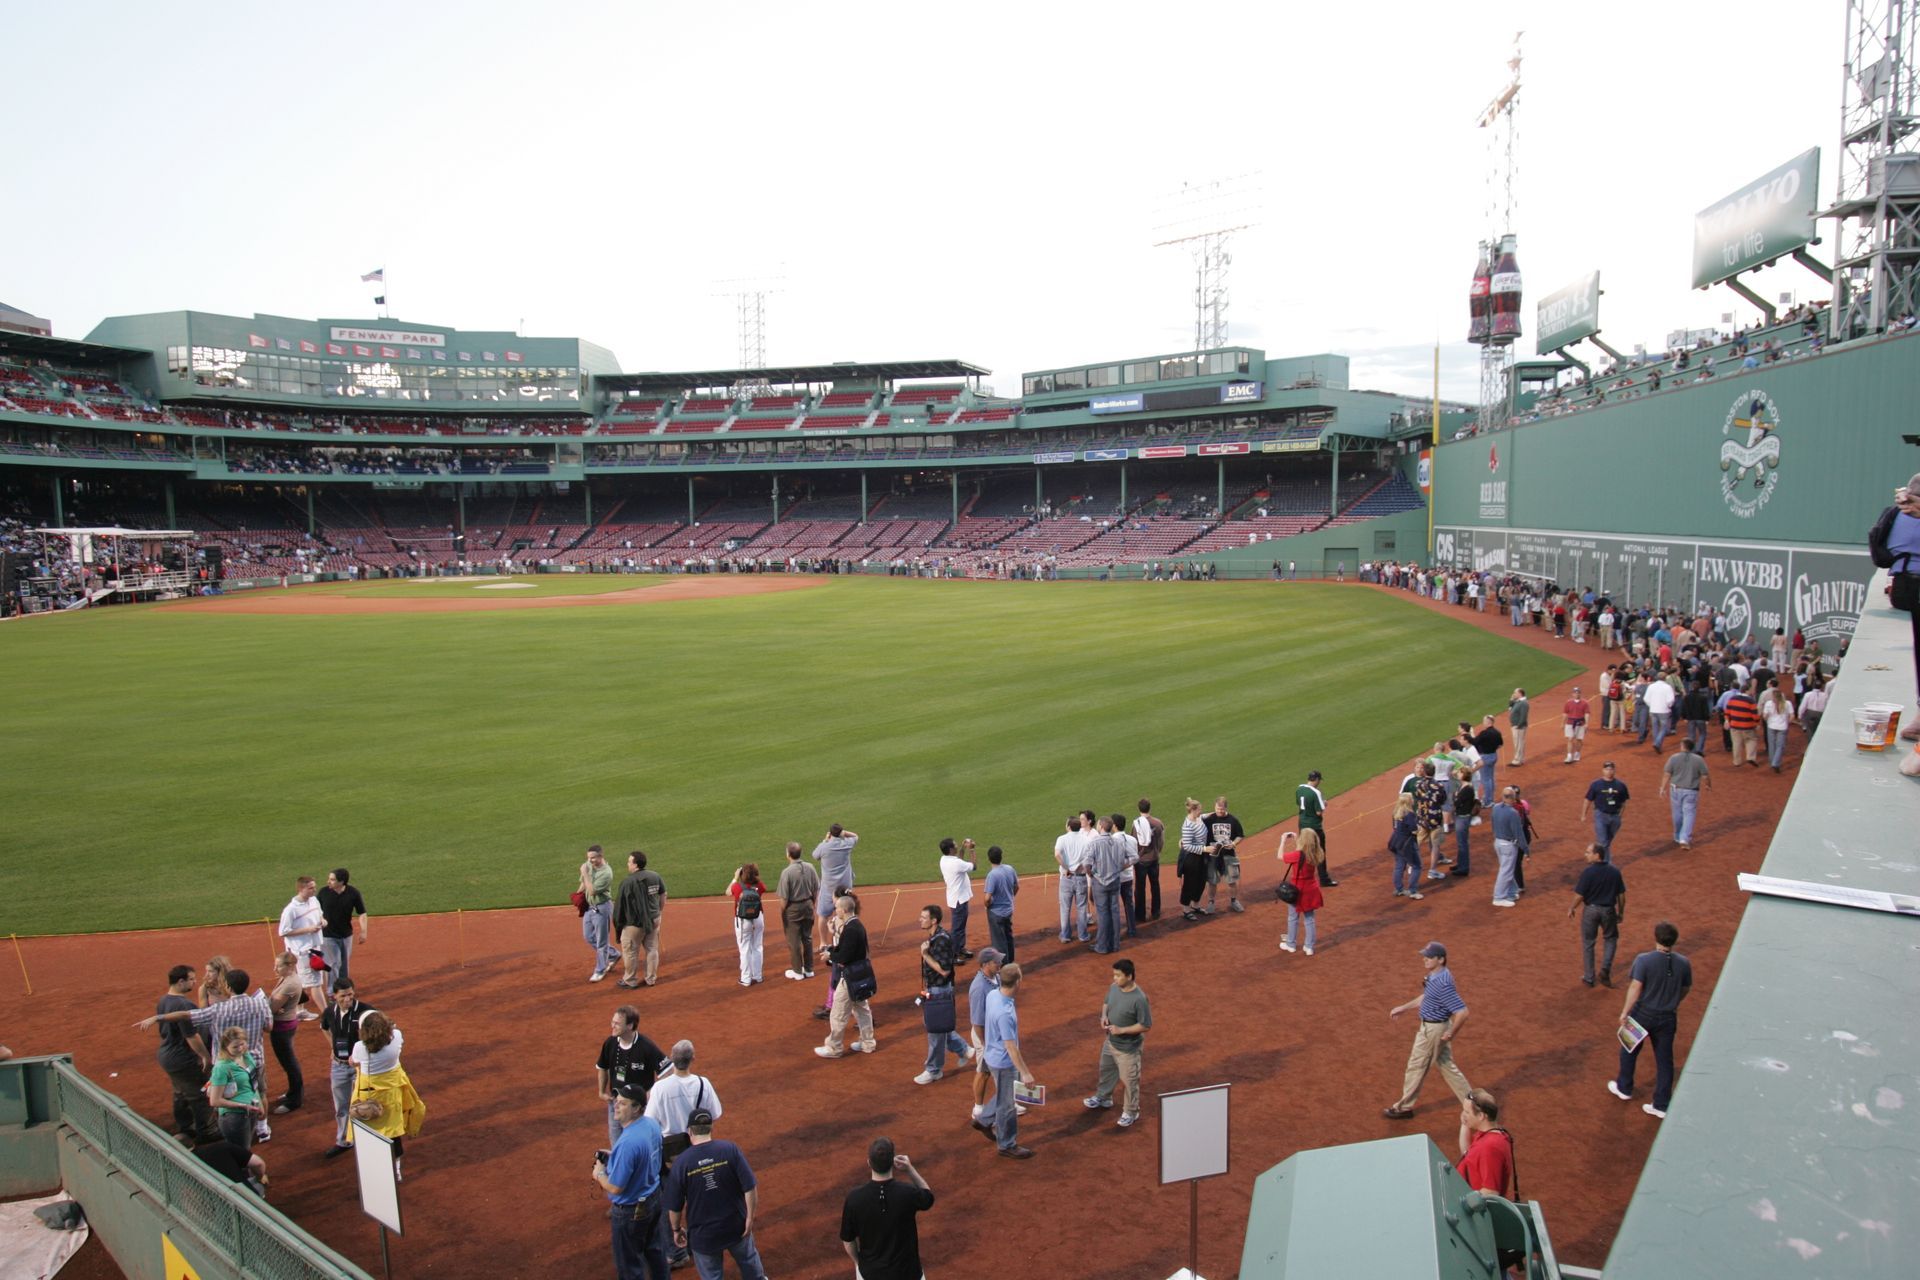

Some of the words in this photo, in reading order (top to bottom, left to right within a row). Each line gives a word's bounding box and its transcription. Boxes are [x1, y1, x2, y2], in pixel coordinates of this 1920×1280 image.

[1723, 240, 1742, 267] for
[1743, 228, 1764, 258] life
[339, 330, 393, 341] FENWAY
[403, 334, 438, 344] PARK
[1722, 391, 1749, 435] BOSTON
[1750, 389, 1767, 403] RED
[1766, 399, 1781, 425] SOX
[1729, 505, 1756, 519] JIMMY
[1758, 471, 1778, 510] FUND
[1436, 533, 1454, 562] CVS
[1624, 544, 1647, 553] NATIONAL
[1648, 545, 1668, 555] LEAGUE
[1730, 560, 1783, 590] WEBB
[1794, 573, 1865, 626] GRANITE
[1758, 611, 1781, 629] 1866
[1803, 625, 1830, 638] LECTRIC
[1831, 618, 1858, 631] SUPP
[1300, 796, 1306, 810] 1
